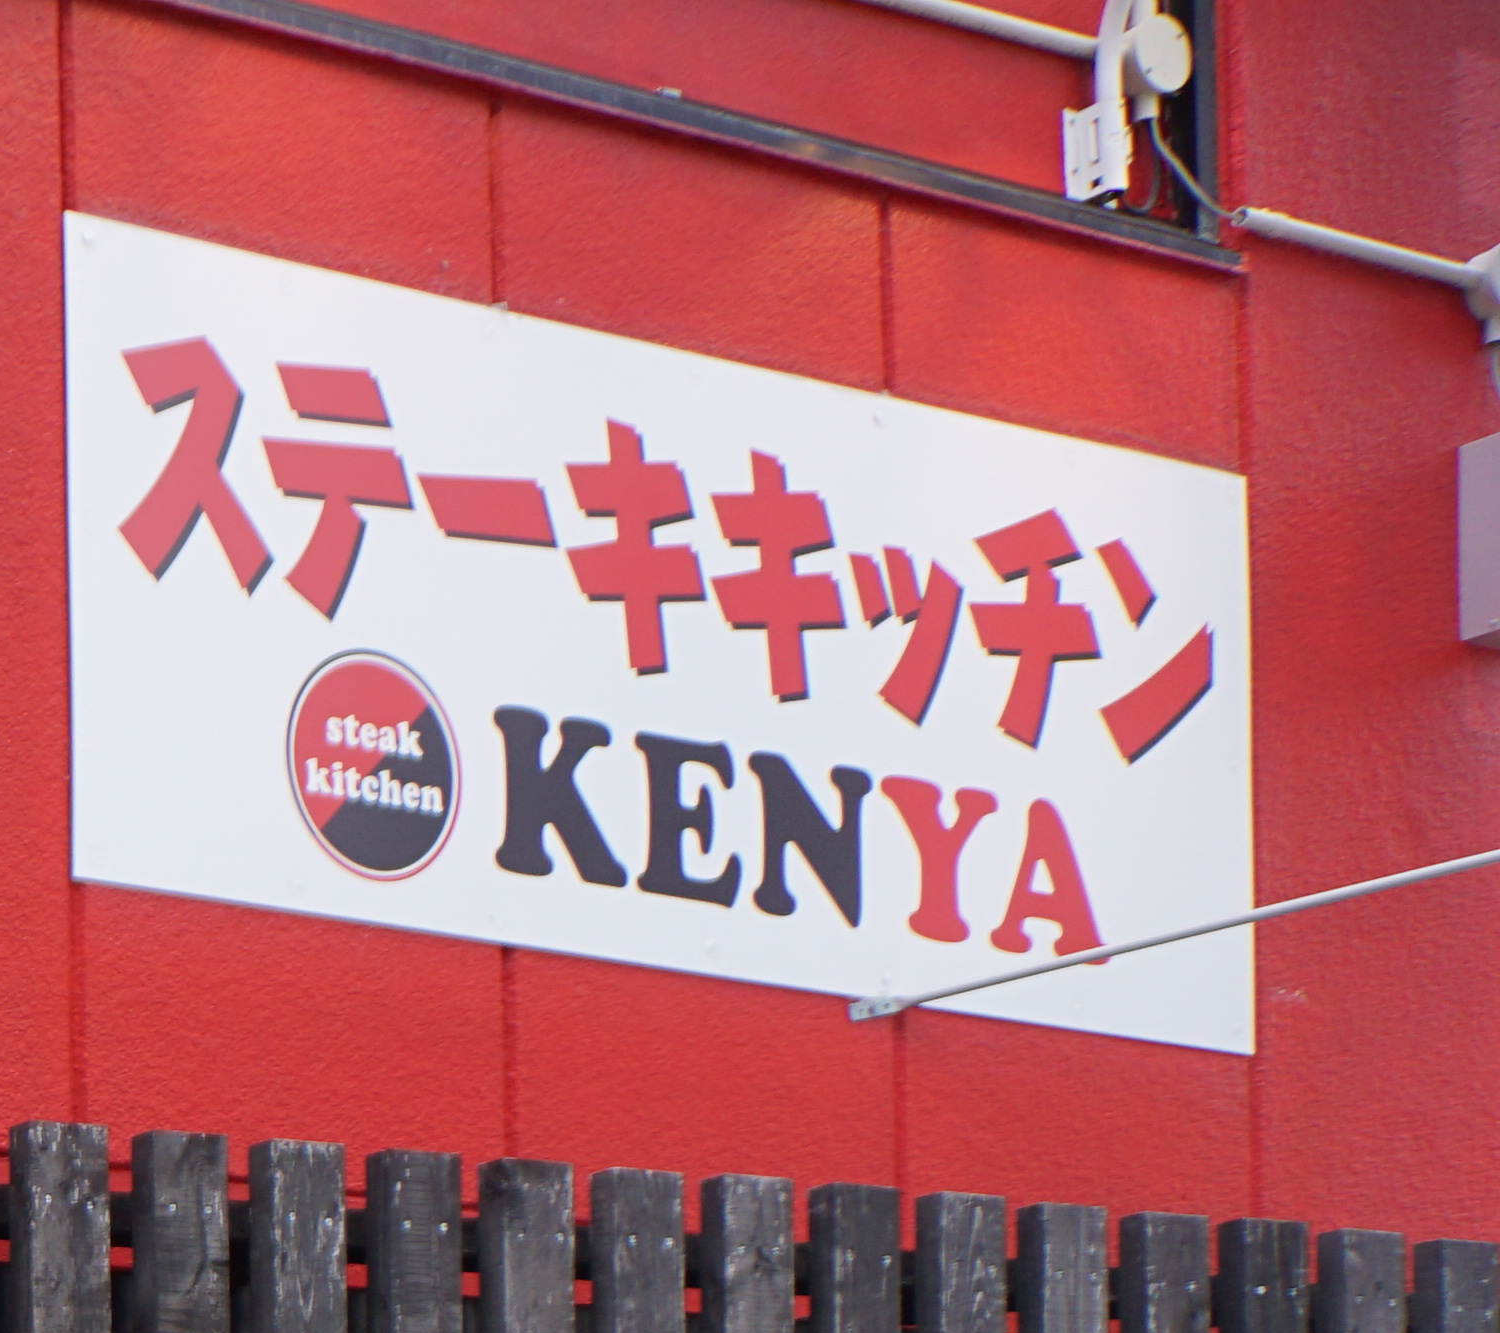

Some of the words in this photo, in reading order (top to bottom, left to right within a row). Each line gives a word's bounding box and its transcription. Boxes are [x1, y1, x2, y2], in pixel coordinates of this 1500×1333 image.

[118, 334, 1214, 765] ステーキキッチン
[304, 756, 445, 815] kitchen
[325, 714, 424, 759] steak
[494, 703, 1112, 966] KENYA
